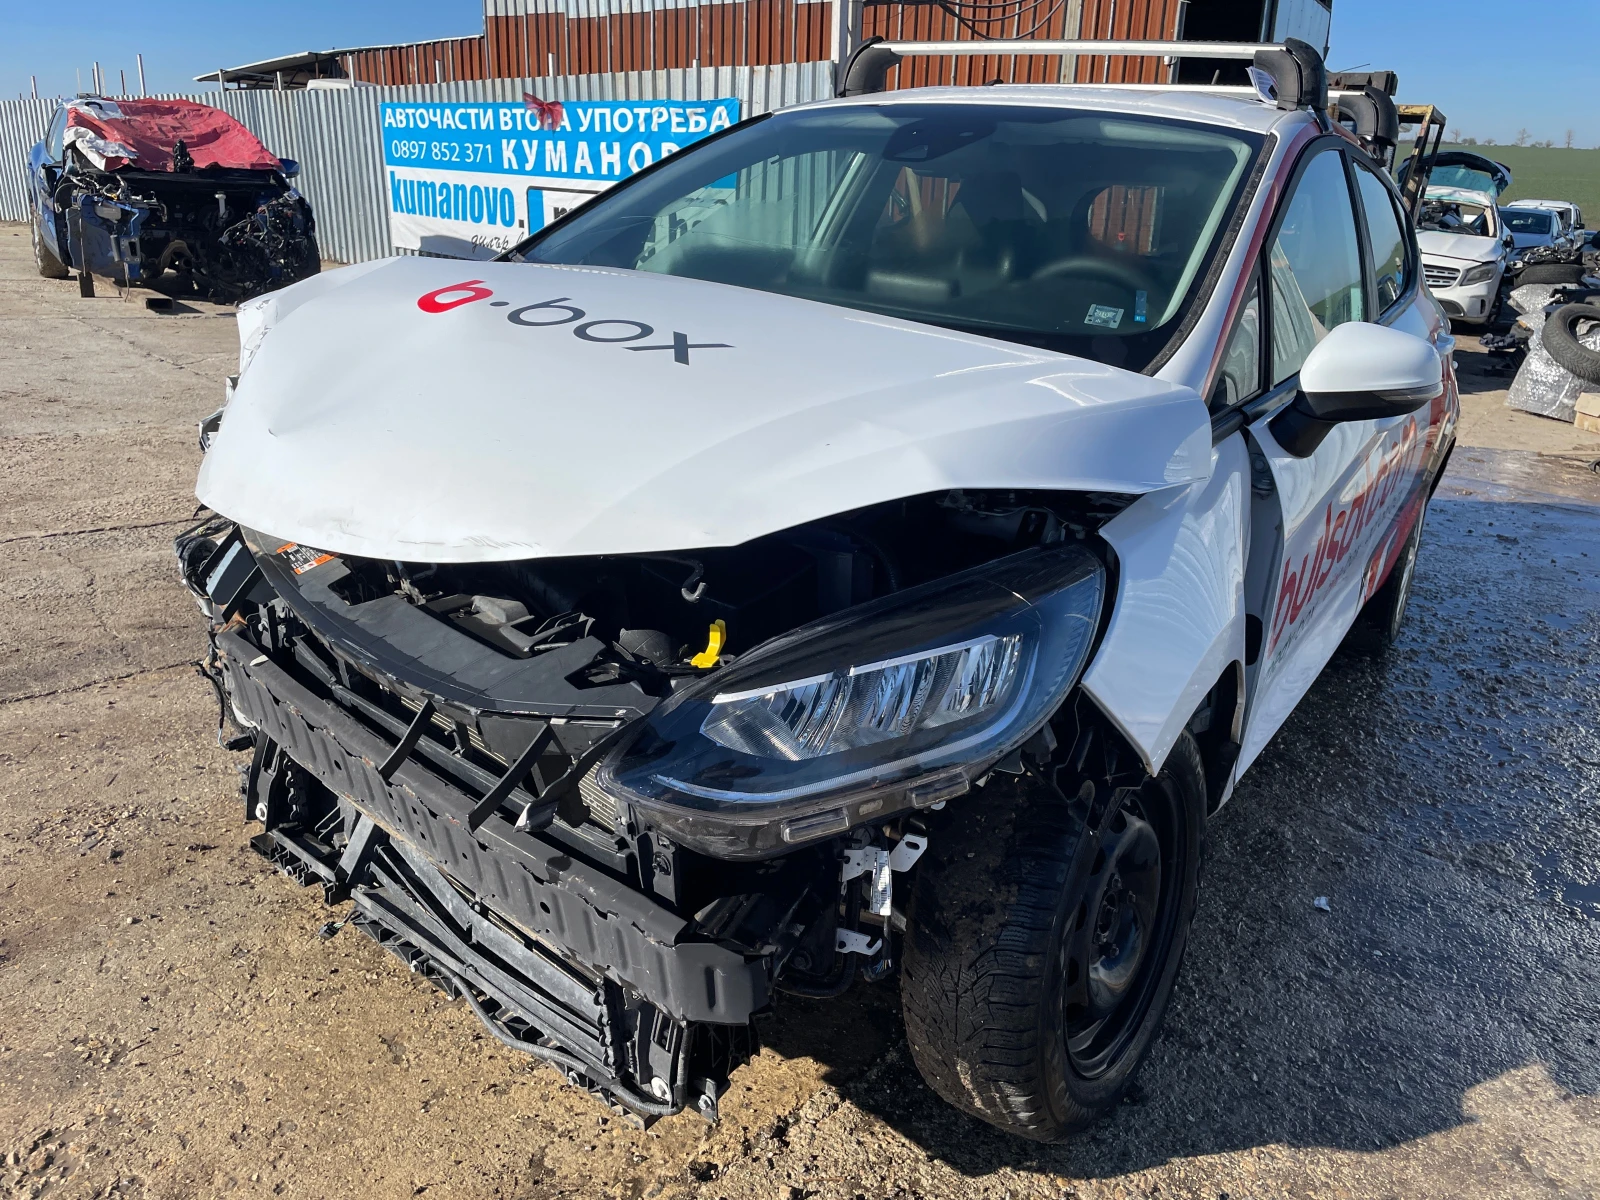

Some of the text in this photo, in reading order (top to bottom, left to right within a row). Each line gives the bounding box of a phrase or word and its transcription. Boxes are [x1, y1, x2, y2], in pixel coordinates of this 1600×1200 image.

[384, 107, 495, 131] АВТОЧАСТИ
[576, 105, 732, 133] УПОТРЕБА
[391, 140, 493, 164] 0897 852 371
